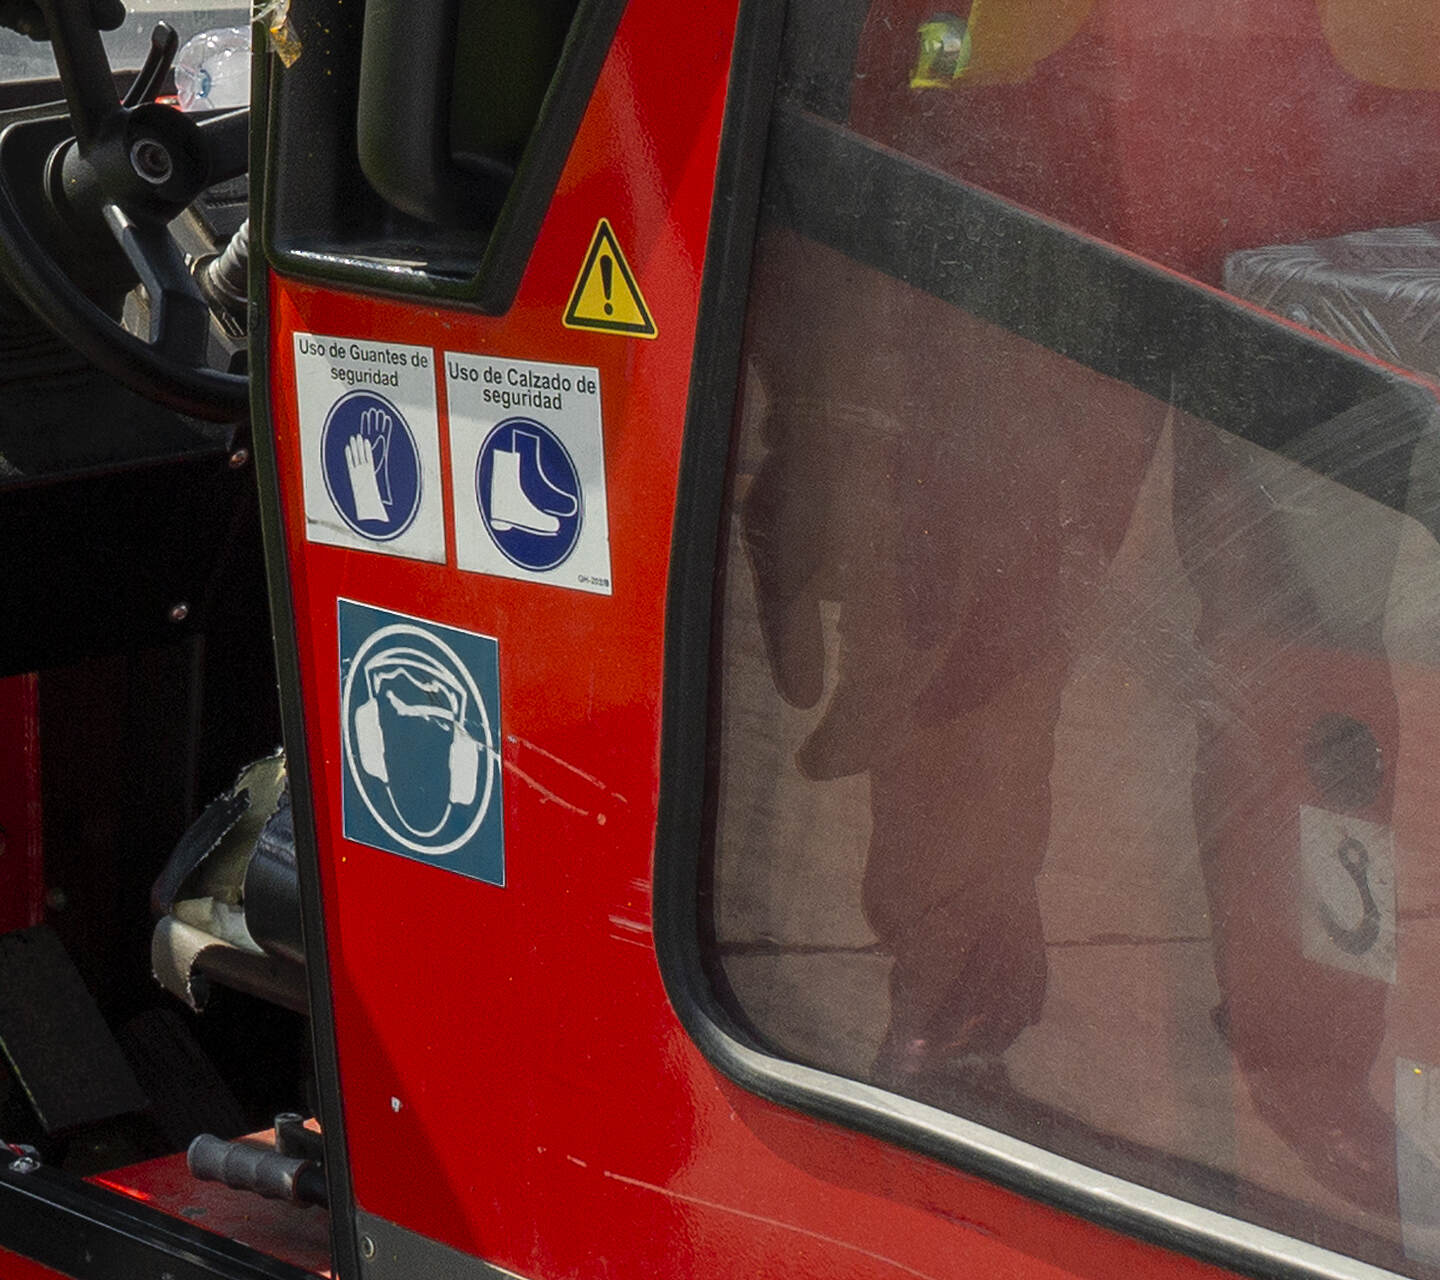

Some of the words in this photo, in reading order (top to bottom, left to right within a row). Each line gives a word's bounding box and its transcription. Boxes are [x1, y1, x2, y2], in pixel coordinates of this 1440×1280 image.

[299, 339, 325, 357] Uso
[329, 342, 346, 359] de
[349, 344, 407, 368] Guantes
[411, 352, 429, 369] de
[330, 366, 399, 388] seguridad
[448, 361, 479, 383] Uso
[483, 365, 502, 385] de
[507, 368, 572, 393] Calzado
[576, 375, 597, 396] de
[482, 388, 563, 412] seguridad
